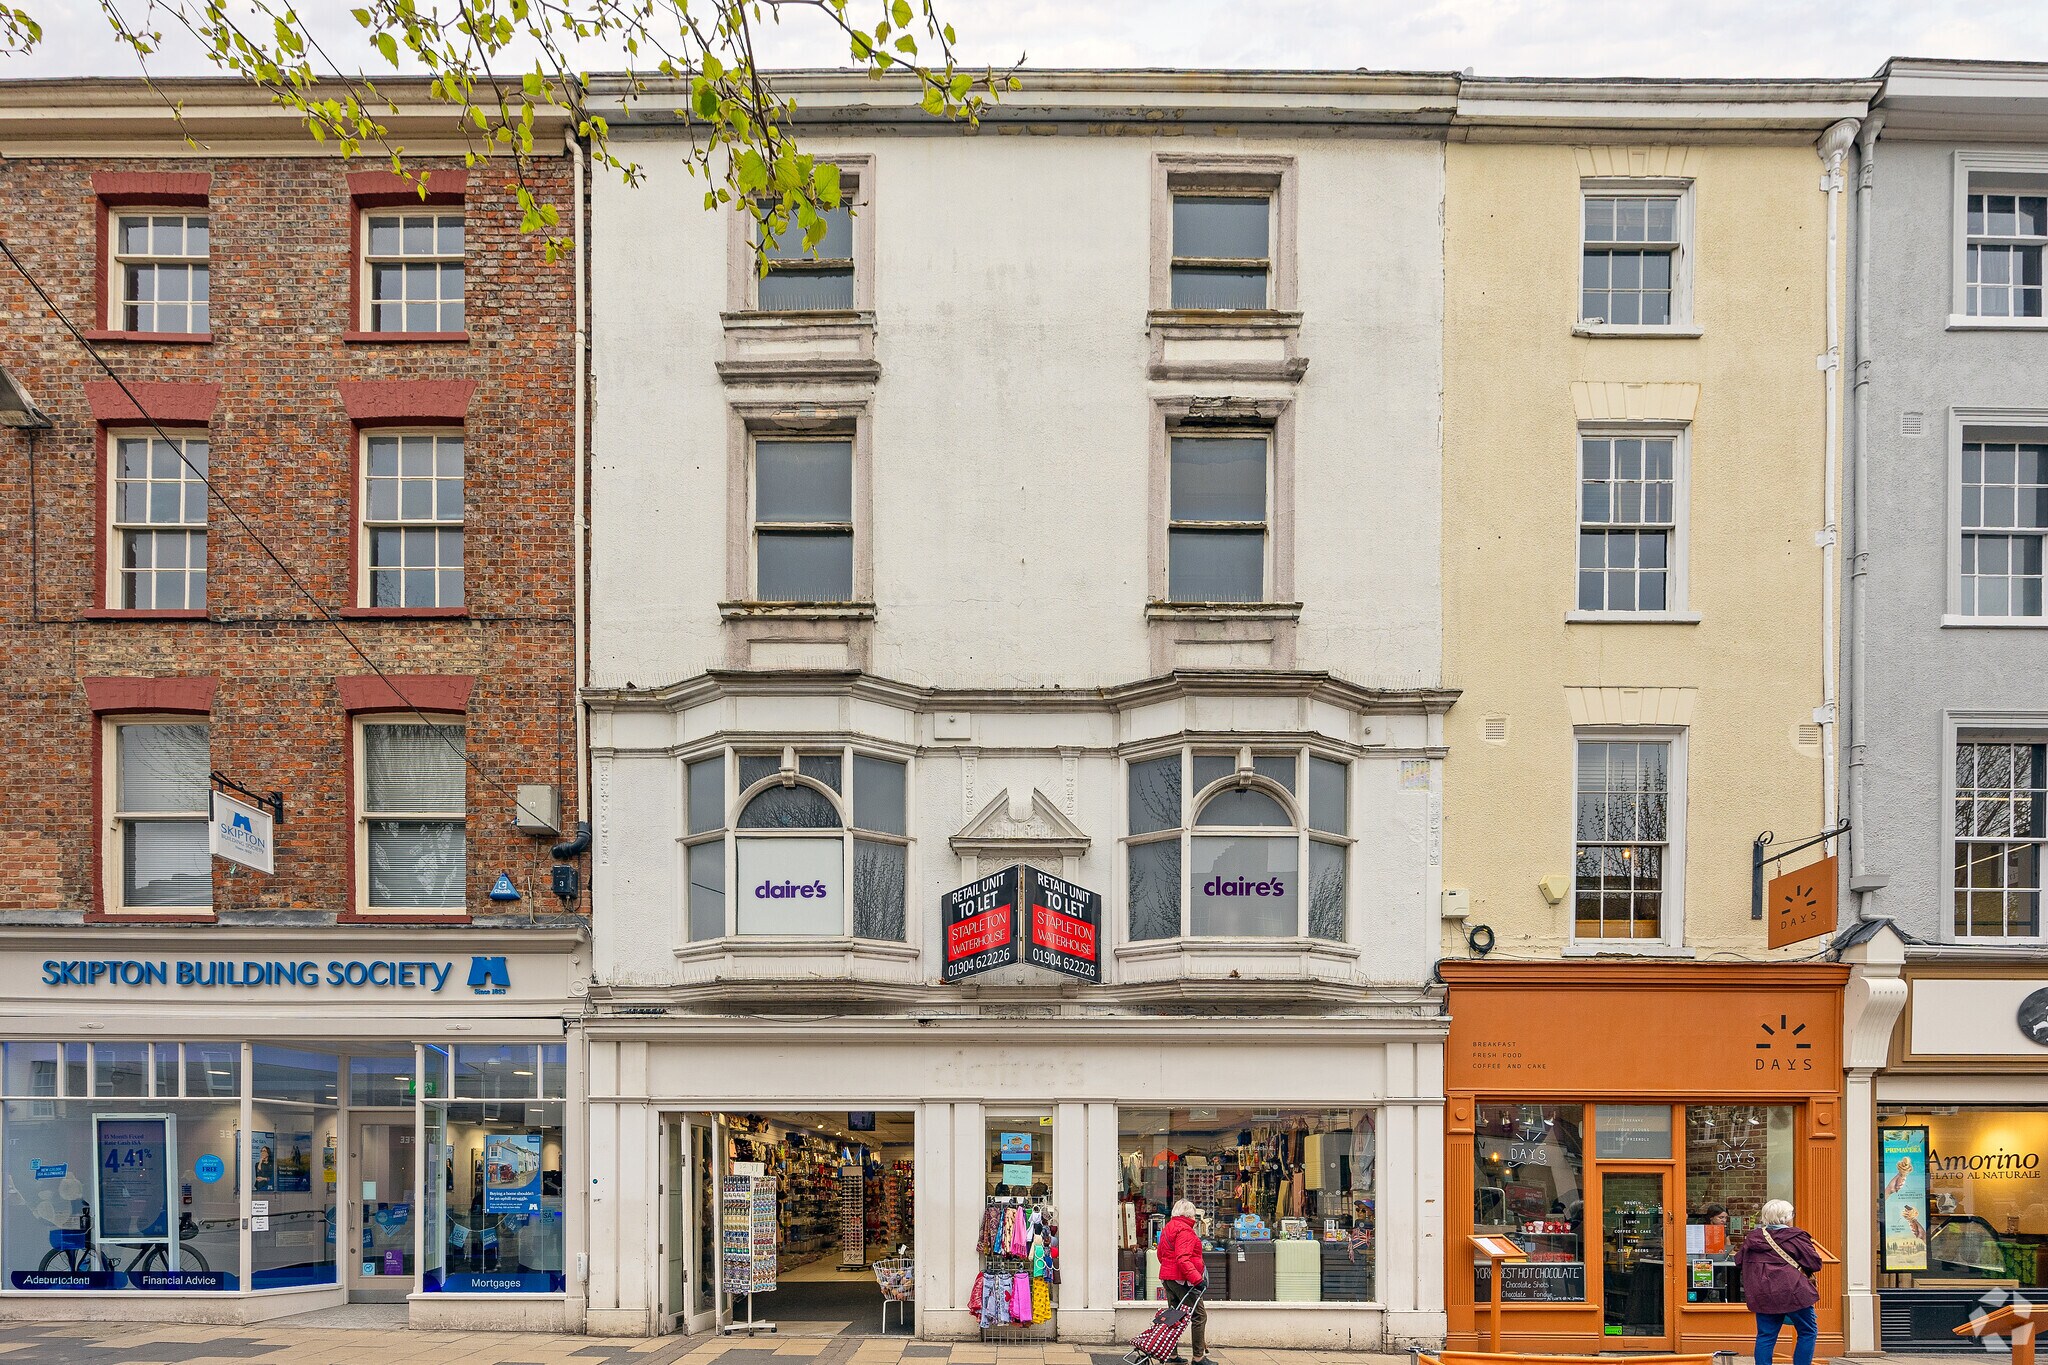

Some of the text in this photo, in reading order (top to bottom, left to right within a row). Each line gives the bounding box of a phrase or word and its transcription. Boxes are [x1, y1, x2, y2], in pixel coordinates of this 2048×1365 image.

[220, 823, 265, 848] SKIPTON
[221, 833, 264, 854] BUILDING SOCIETY
[754, 880, 826, 898] claire's
[952, 872, 1005, 904] RETAIL UNIT
[1037, 872, 1091, 904] RETAIL UNIT
[1203, 876, 1284, 896] claire's
[958, 890, 998, 919] TO LET
[1045, 890, 1085, 919] TO LET
[951, 911, 1006, 941] STAPLETON
[1037, 911, 1092, 941] STAPLETON
[1780, 910, 1817, 930] DAYS
[952, 928, 1006, 955] WATERHOUSE
[1037, 928, 1092, 956] WATERHOUSE
[948, 947, 1010, 977] 01904 622226
[1032, 948, 1095, 977] 01904 622226
[42, 960, 452, 992] SKIPTON BUILDING SOCIETY
[1755, 1058, 1812, 1070] DAYS
[1511, 1148, 1546, 1160] DAYS
[1717, 1152, 1756, 1163] DAYS
[1928, 1148, 2040, 1171] Amorino
[142, 1275, 216, 1285] Financial Advice
[471, 1278, 521, 1289] Mortgages
[1518, 1268, 1534, 1278] HOT
